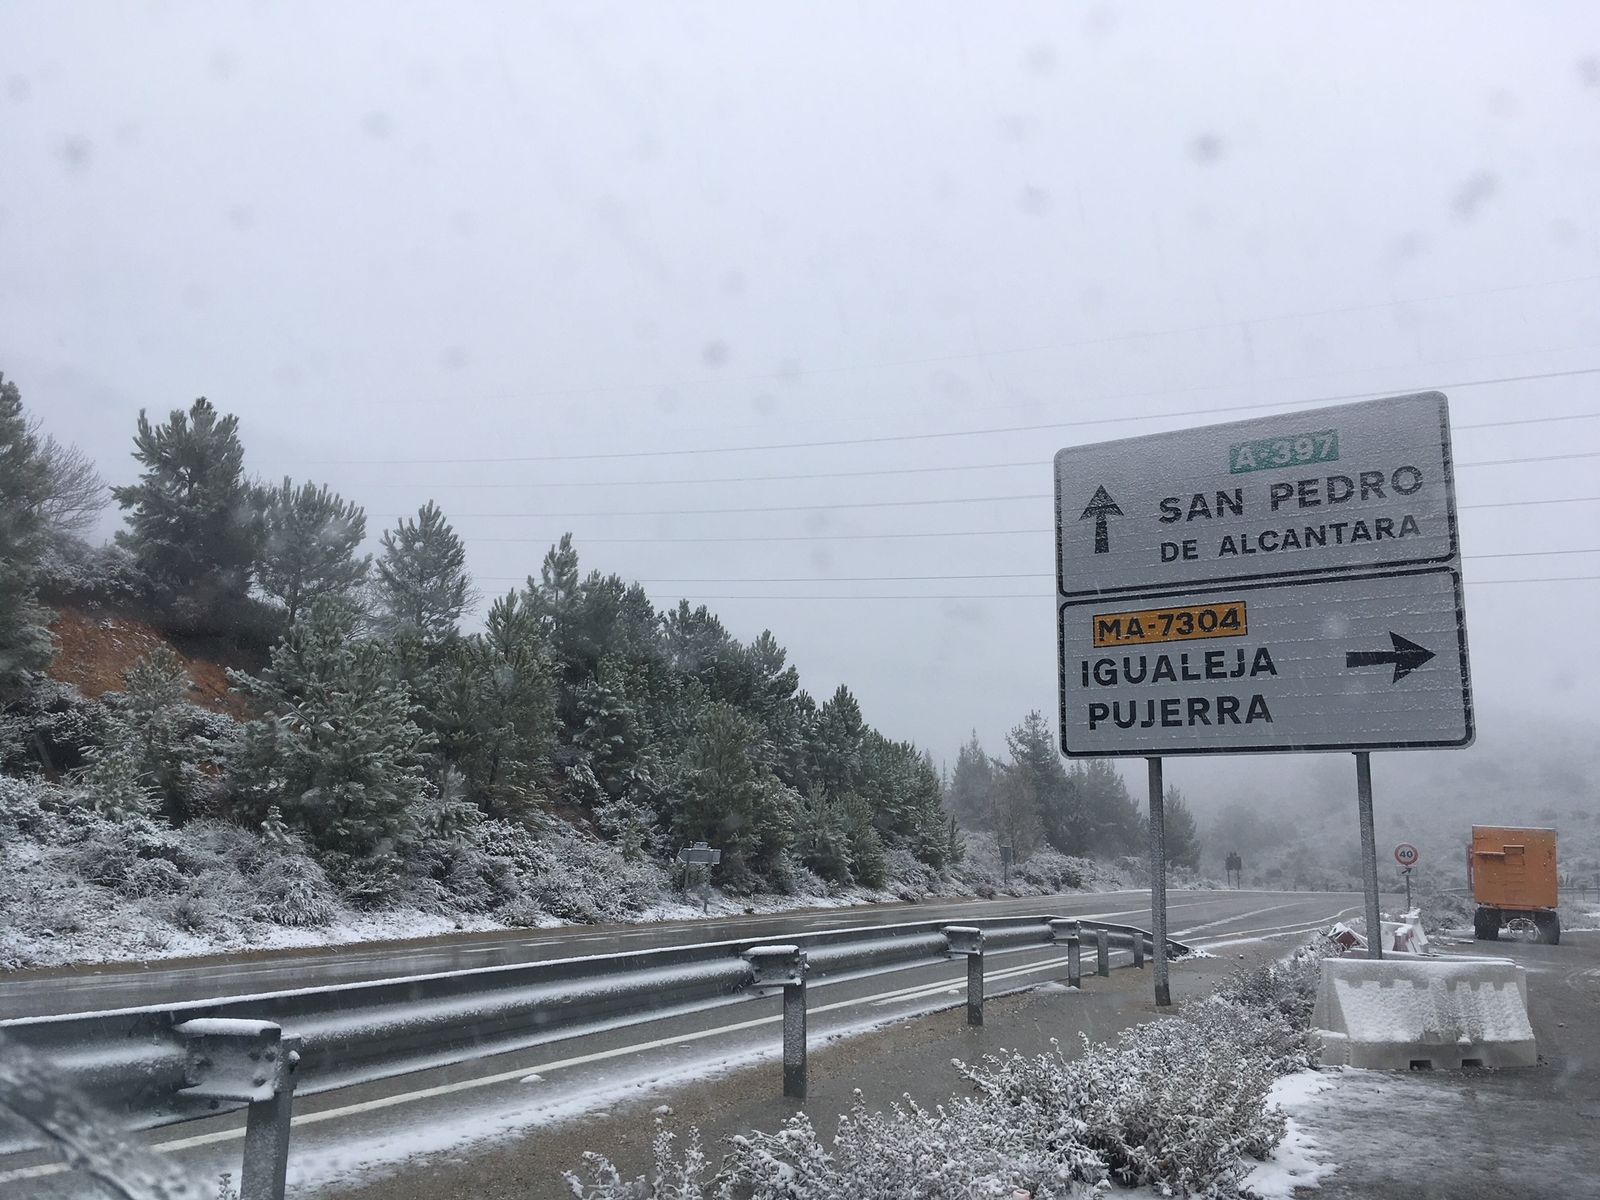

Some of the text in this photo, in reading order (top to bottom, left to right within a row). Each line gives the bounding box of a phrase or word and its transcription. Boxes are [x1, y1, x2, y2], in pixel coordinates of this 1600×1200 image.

[1235, 431, 1334, 468] A-397
[1159, 465, 1423, 525] SAN PEDRO
[1161, 515, 1421, 563] DE ALCANTARA
[1098, 607, 1241, 641] MA-7304
[1081, 647, 1278, 687] IGUALEJA
[1088, 694, 1273, 730] PUJERRA
[1399, 850, 1413, 858] 40
